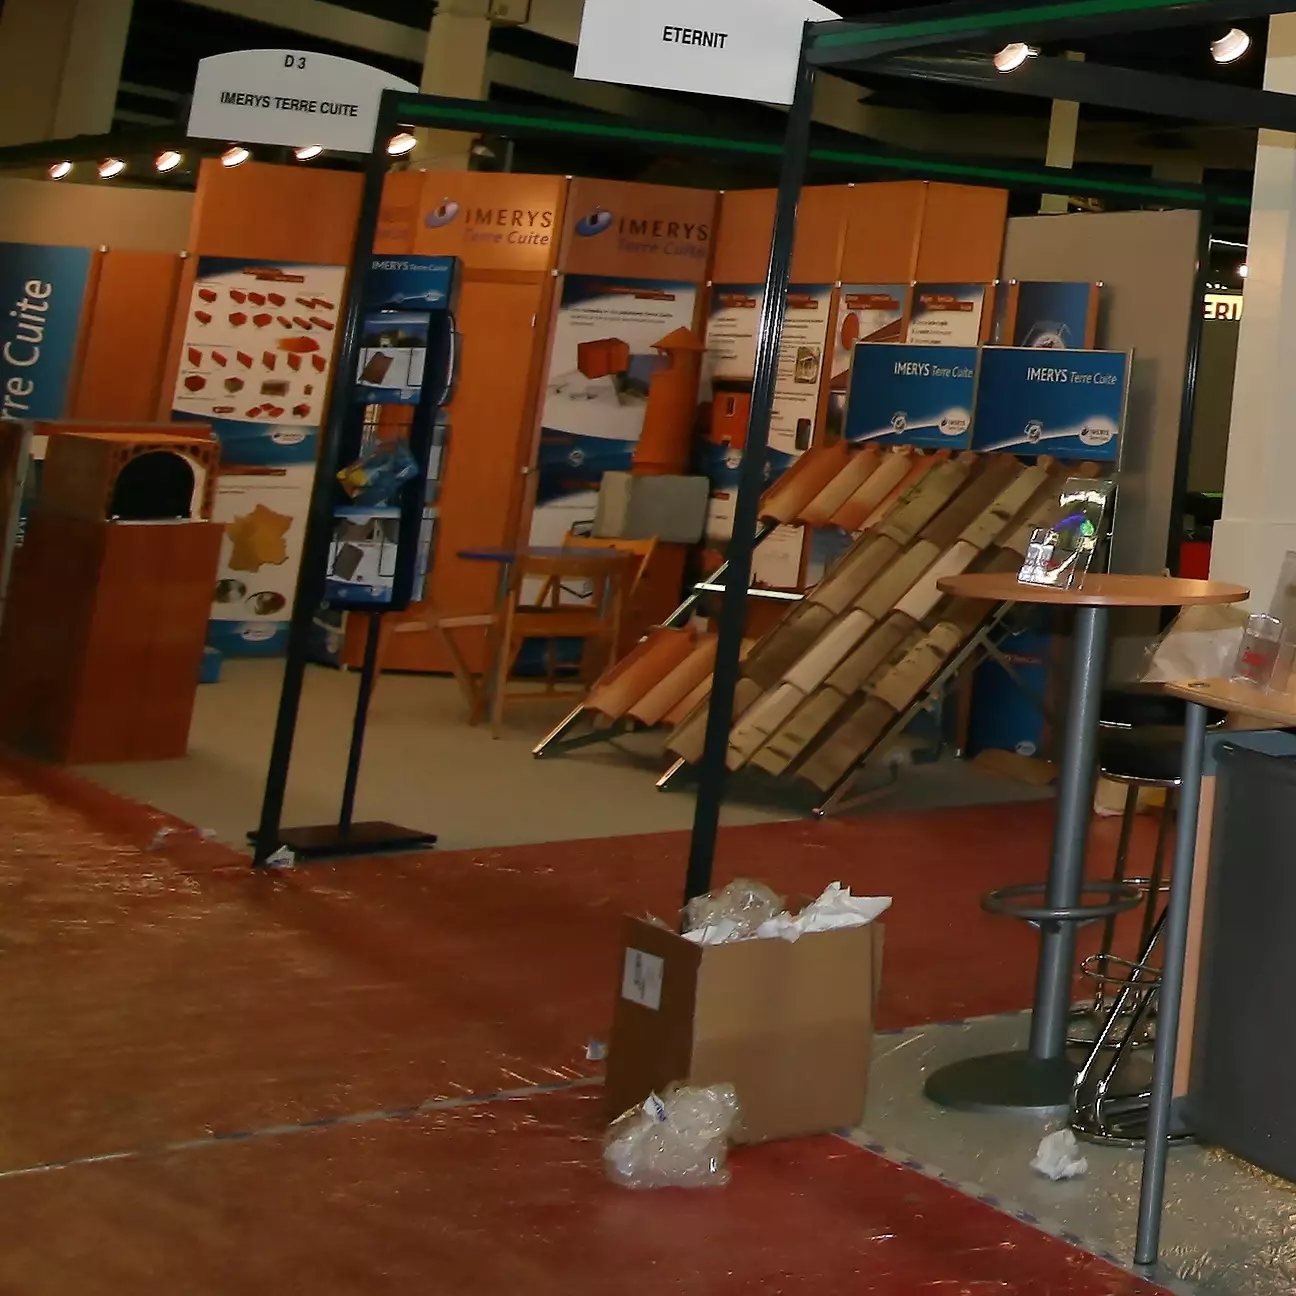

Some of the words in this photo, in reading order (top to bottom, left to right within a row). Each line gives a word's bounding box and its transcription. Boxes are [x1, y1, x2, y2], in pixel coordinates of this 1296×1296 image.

[663, 25, 728, 49] ETERNIT
[284, 54, 294, 68] D
[298, 57, 306, 69] 3
[220, 91, 270, 108] IMERYS
[274, 97, 317, 113] TERRE
[320, 101, 358, 117] CUITE
[464, 207, 552, 228] IMERYS
[508, 230, 549, 245] Cuite
[618, 217, 708, 241] IMERYS
[3, 279, 52, 367] Cuite
[894, 361, 930, 377] IMERYS
[931, 365, 951, 378] Terre
[1027, 367, 1068, 383] IMERYS
[1070, 371, 1092, 384] Terre
